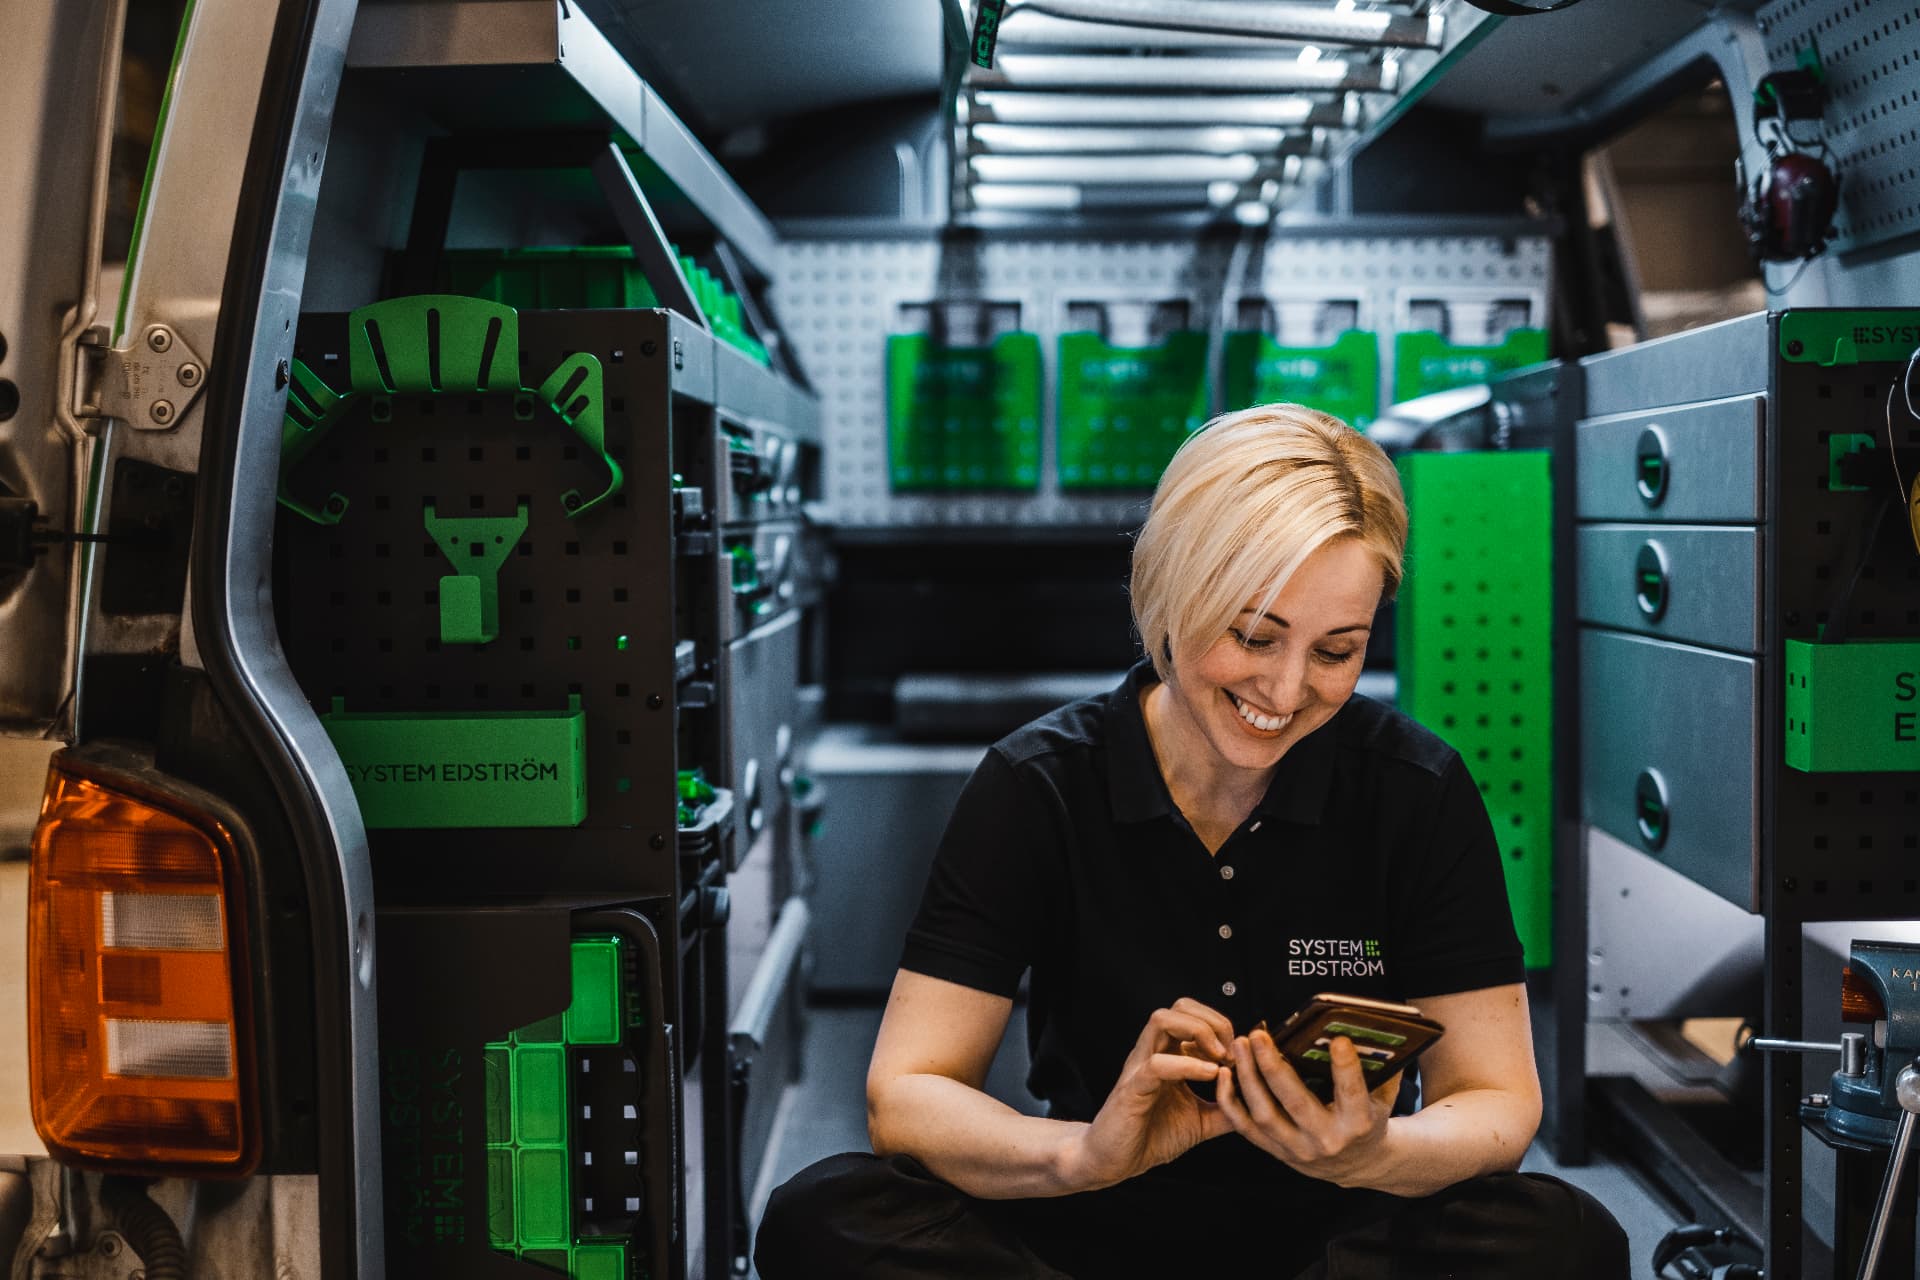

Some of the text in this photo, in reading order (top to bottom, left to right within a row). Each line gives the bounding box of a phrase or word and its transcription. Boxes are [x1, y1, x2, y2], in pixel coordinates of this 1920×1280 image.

[443, 758, 558, 782] EDSTRÖM
[1289, 939, 1363, 957] SYSTEM
[1289, 957, 1385, 977] EDSTRÖM
